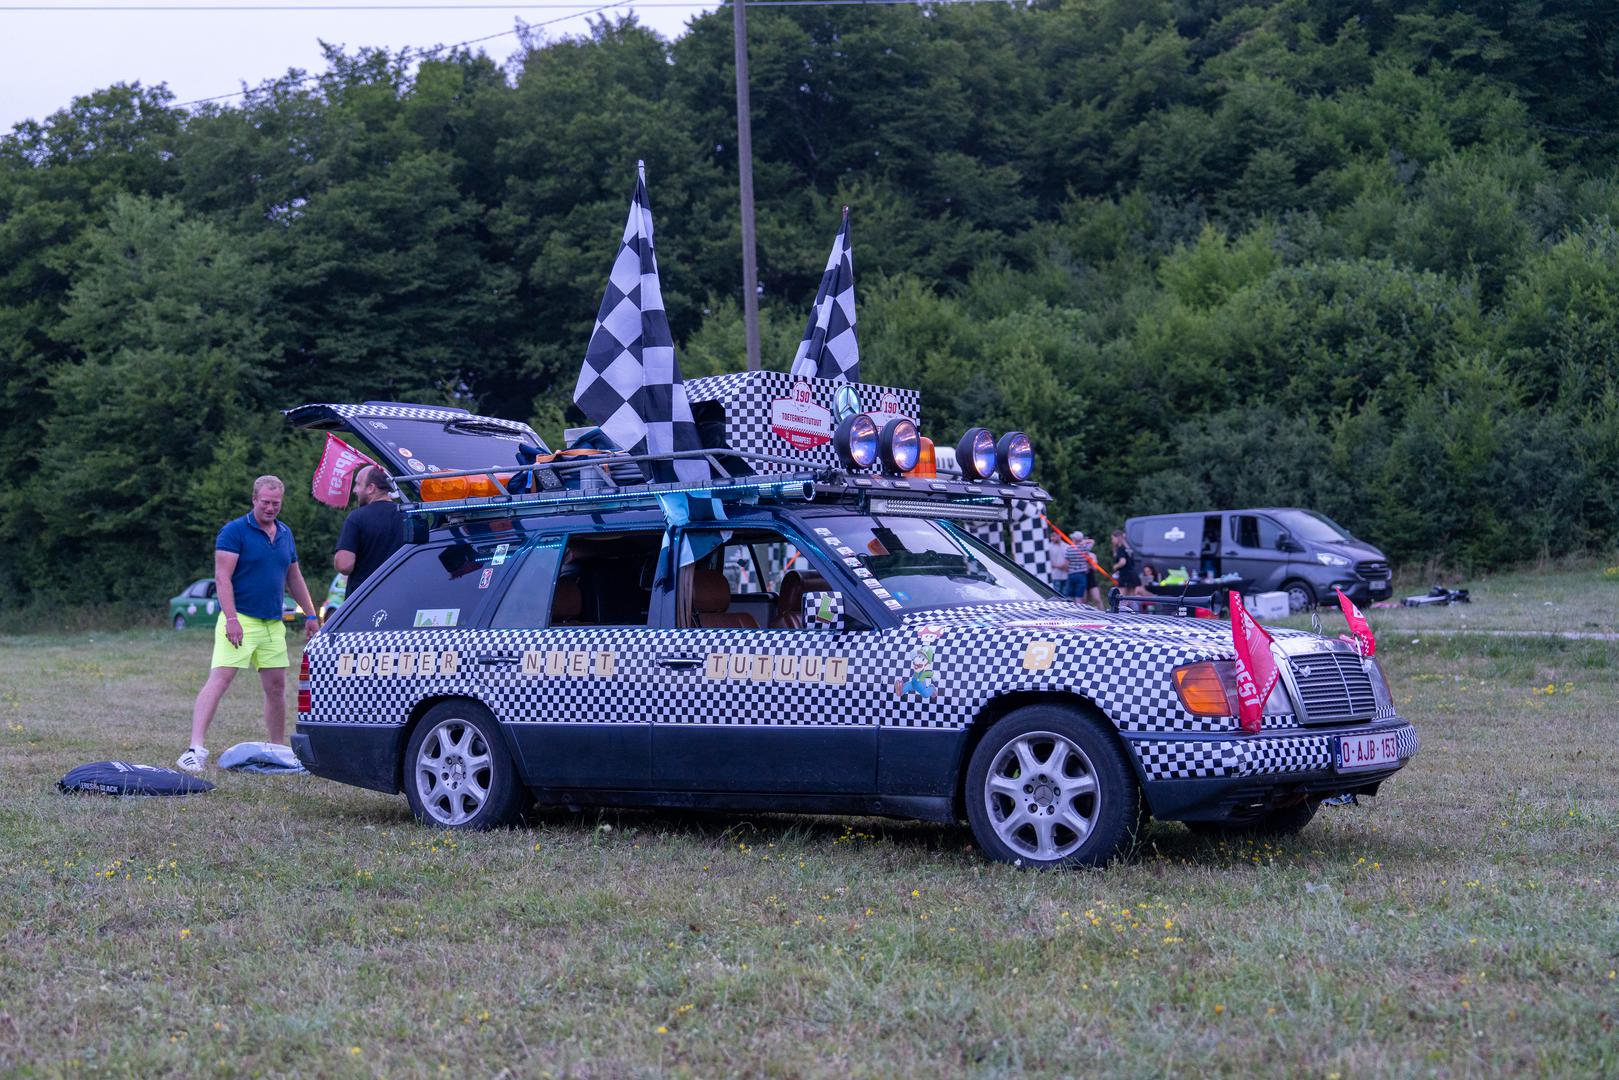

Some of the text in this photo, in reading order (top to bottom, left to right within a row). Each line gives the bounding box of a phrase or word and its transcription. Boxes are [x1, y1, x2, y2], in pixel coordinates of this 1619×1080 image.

[796, 390, 810, 403] 190
[884, 402, 897, 414] 190
[342, 654, 454, 672] TOETER
[526, 653, 611, 671] NIET
[712, 655, 843, 678] TUTUUT
